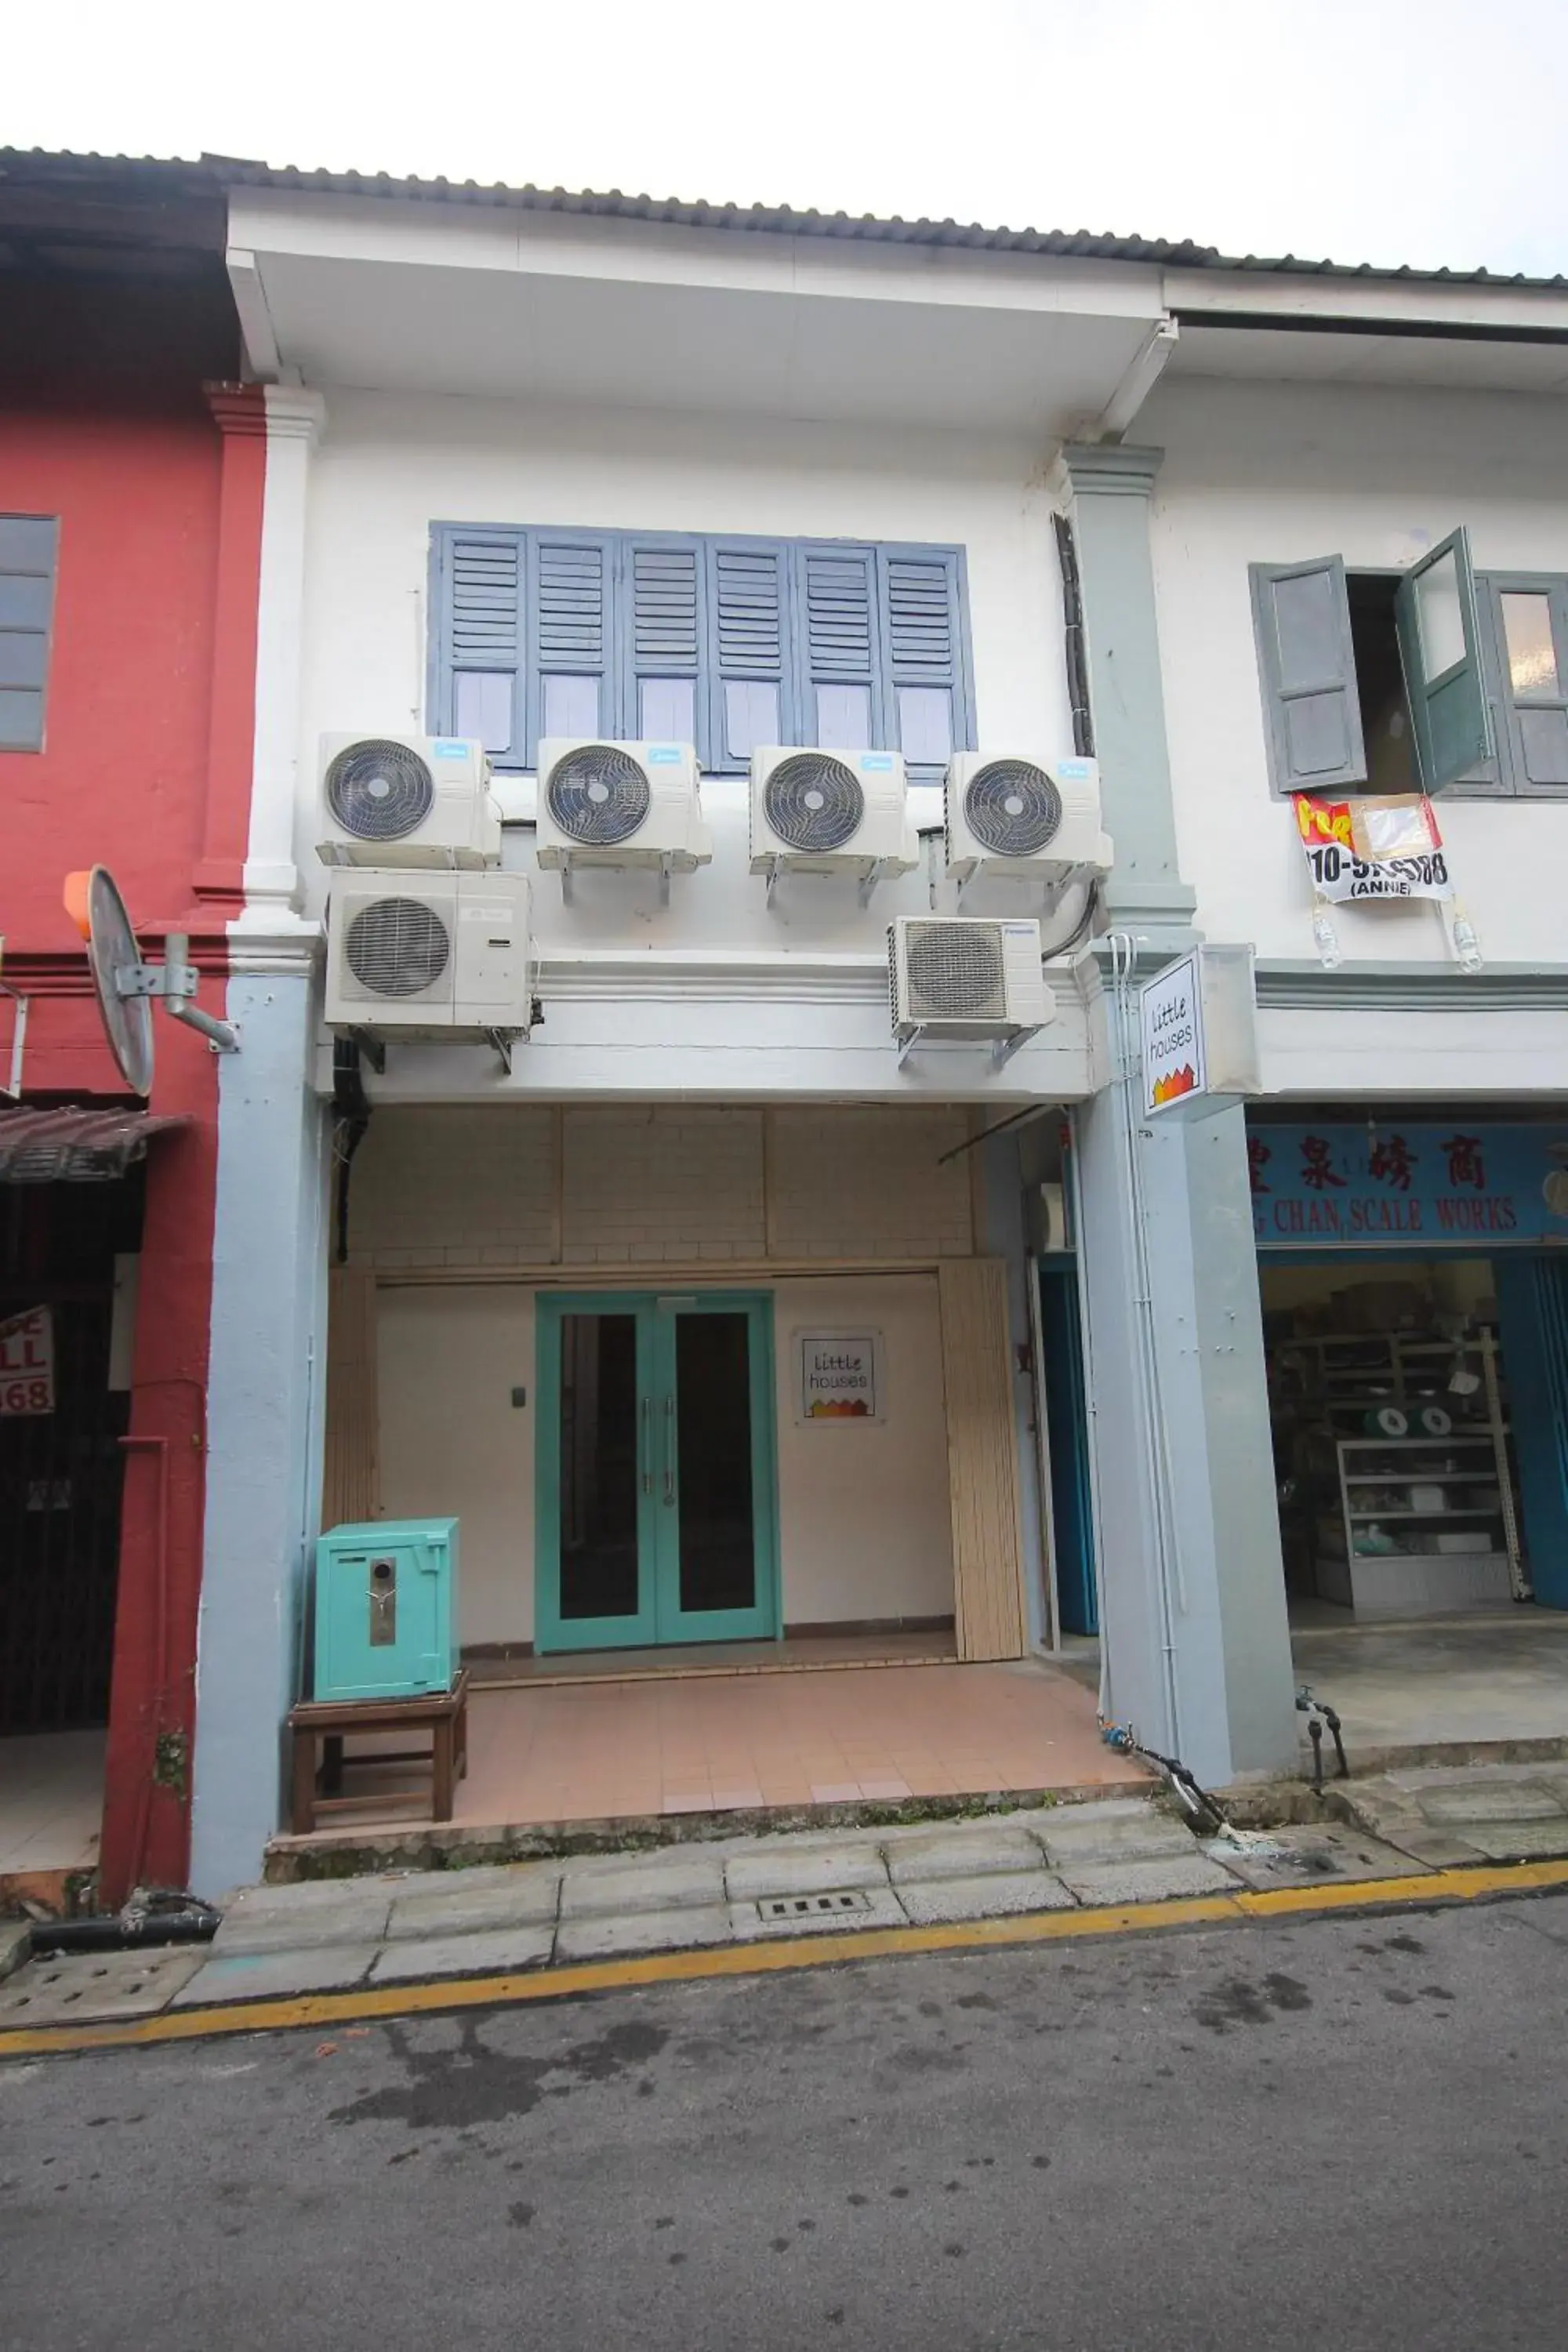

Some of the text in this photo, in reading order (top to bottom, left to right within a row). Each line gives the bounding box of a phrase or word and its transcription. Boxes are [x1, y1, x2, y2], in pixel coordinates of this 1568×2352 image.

[1351, 880, 1411, 897] (ANNIE)
[1149, 1023, 1193, 1062] houses
[1274, 1199, 1340, 1232] CHAN
[1350, 1199, 1421, 1231] SCALE
[1435, 1197, 1517, 1231] WORKS
[0, 1380, 49, 1411] 68
[810, 1374, 867, 1389] houses
